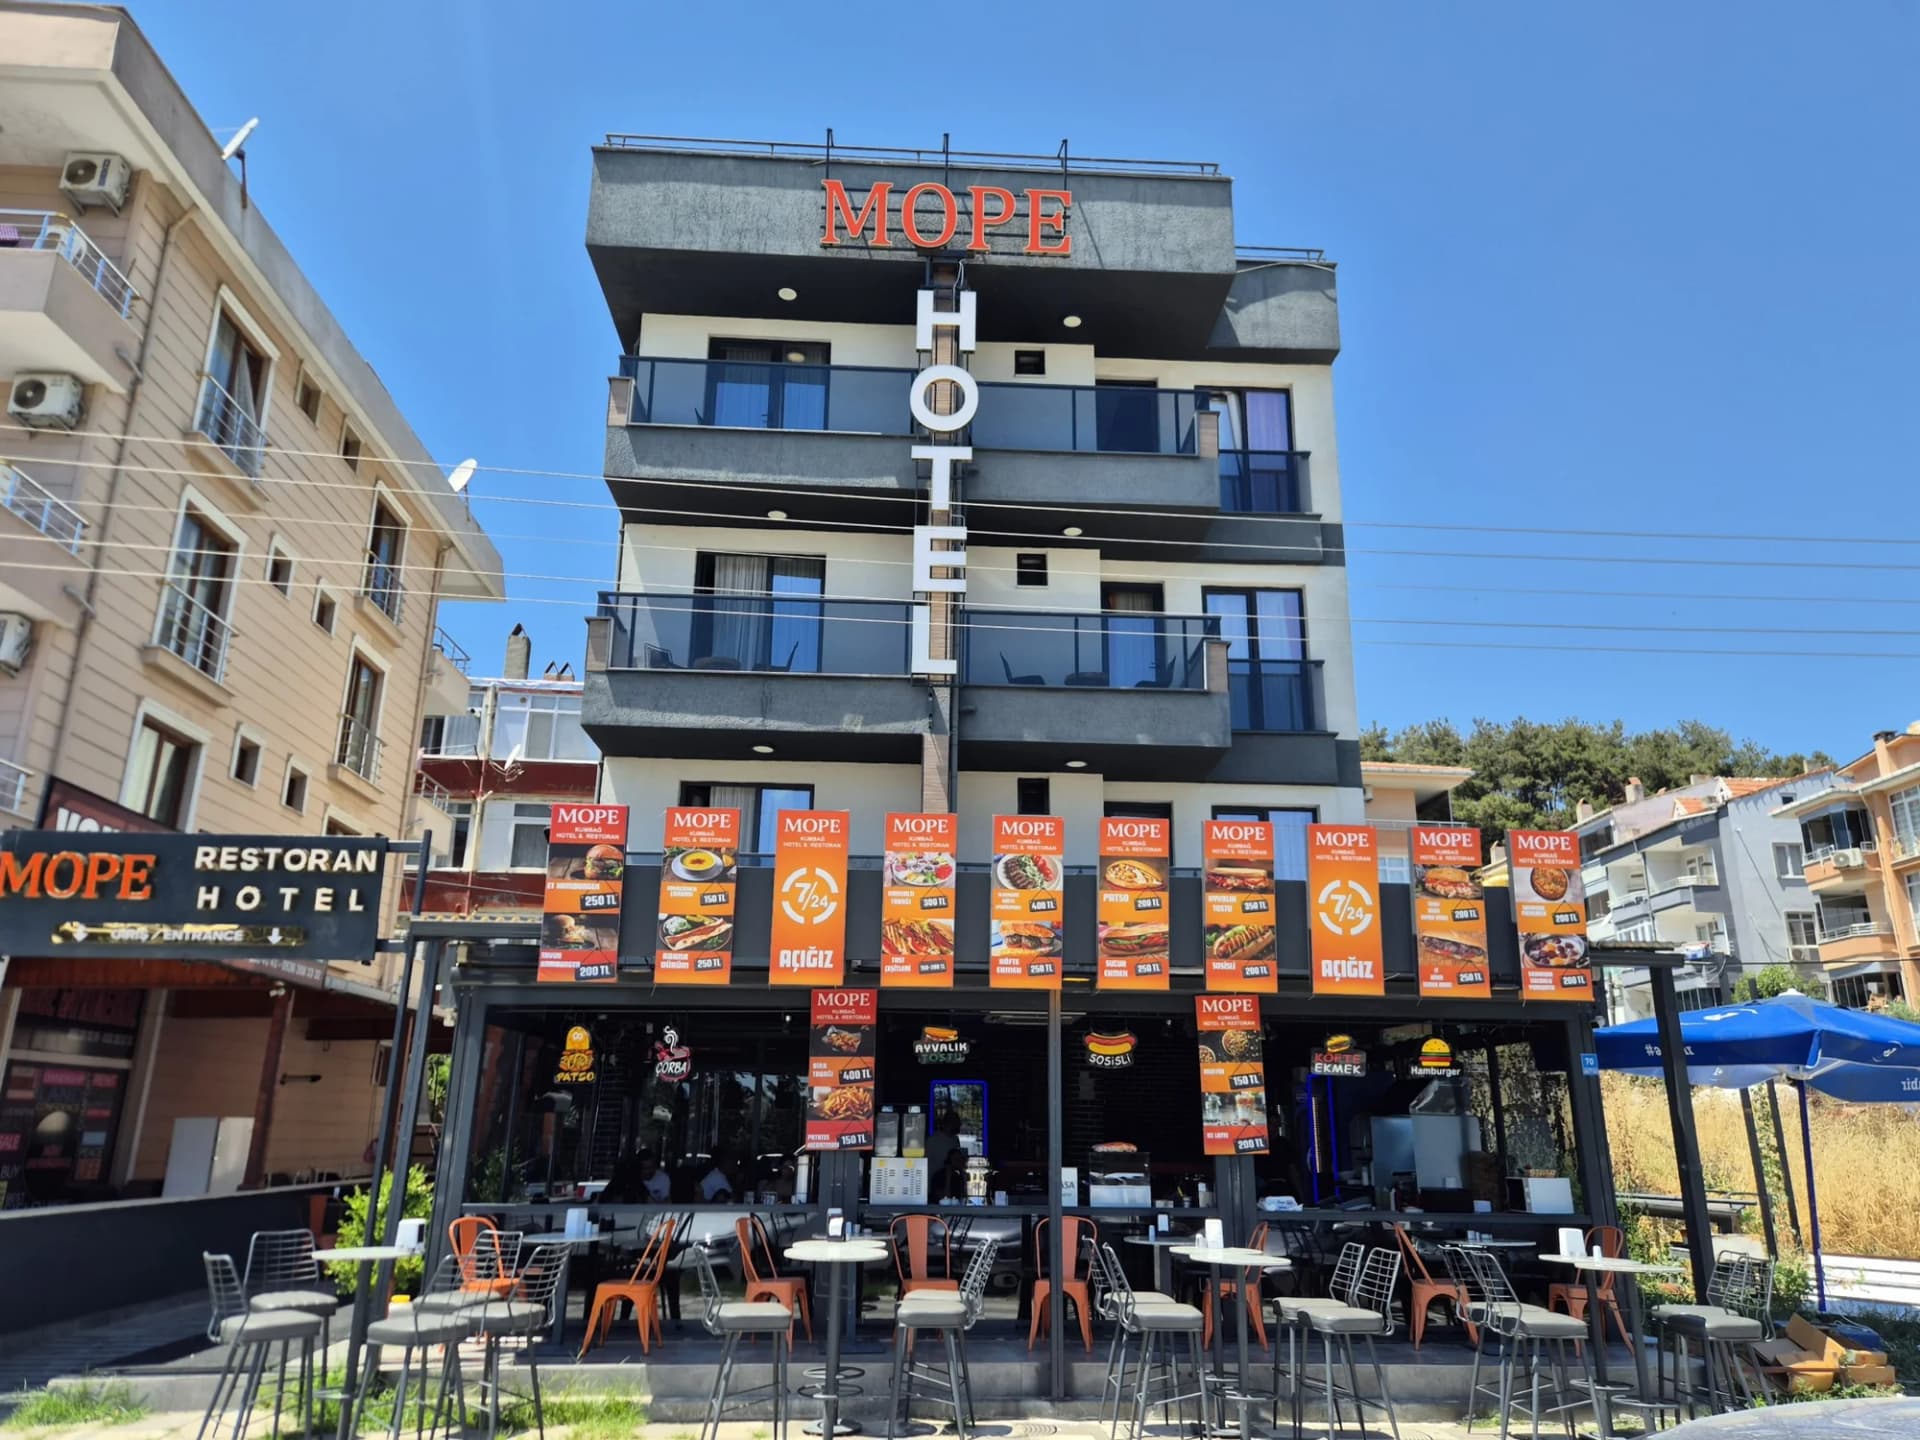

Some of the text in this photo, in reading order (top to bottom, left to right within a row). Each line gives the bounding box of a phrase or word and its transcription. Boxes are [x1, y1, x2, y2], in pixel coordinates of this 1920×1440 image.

[821, 179, 1072, 256] MOPE
[910, 289, 979, 675] HOTEL
[557, 807, 620, 824] MOPE
[673, 812, 732, 828] MOPE
[784, 818, 840, 834] MOPE
[893, 818, 949, 834] MOPE
[1000, 821, 1056, 836] MOPE
[1106, 822, 1161, 838] MOPE
[1212, 825, 1266, 840] MOPE
[1316, 832, 1369, 848] MOPE
[1420, 832, 1473, 848] MOPE
[1518, 835, 1572, 851] MOPE
[194, 846, 378, 872] RESTORAN
[0, 850, 156, 899] MOPE
[196, 885, 365, 912] HOTEL
[584, 894, 617, 906] 250 TL
[703, 894, 727, 904] 150 TL
[795, 881, 829, 912] 7/24
[938, 897, 946, 906] TL
[1137, 898, 1160, 908] 200 TL
[1031, 901, 1046, 910] 400
[1047, 900, 1055, 909] TL
[1244, 901, 1268, 911] 350 TL
[1330, 894, 1364, 922] 7/24
[1454, 910, 1468, 919] 200
[1469, 909, 1478, 918] TL
[1555, 914, 1578, 924] 200 TL
[697, 958, 722, 968] 250 TL
[779, 946, 834, 973] AÇIĞIZ
[580, 965, 611, 977] 200 TL
[1030, 964, 1054, 973] 250 TL
[1137, 963, 1160, 974] 250 TL
[1245, 966, 1268, 976] 200 TL
[1321, 956, 1374, 982] AÇIĞIZ
[1459, 972, 1482, 982] 250 TL
[1562, 976, 1577, 986] 200
[1577, 976, 1586, 984] TL
[817, 992, 870, 1006] MOPE
[1202, 998, 1253, 1013] MOPE
[915, 1042, 968, 1054] AYVALIK
[656, 1060, 688, 1077] ÇORBA
[843, 1069, 872, 1080] 400 TL
[1314, 1062, 1362, 1074] EKMEK
[1410, 1066, 1461, 1077] Hamburger
[1233, 1075, 1260, 1086] 150 TL
[841, 1134, 866, 1145] 150 TL
[1238, 1138, 1264, 1150] 200 TL
